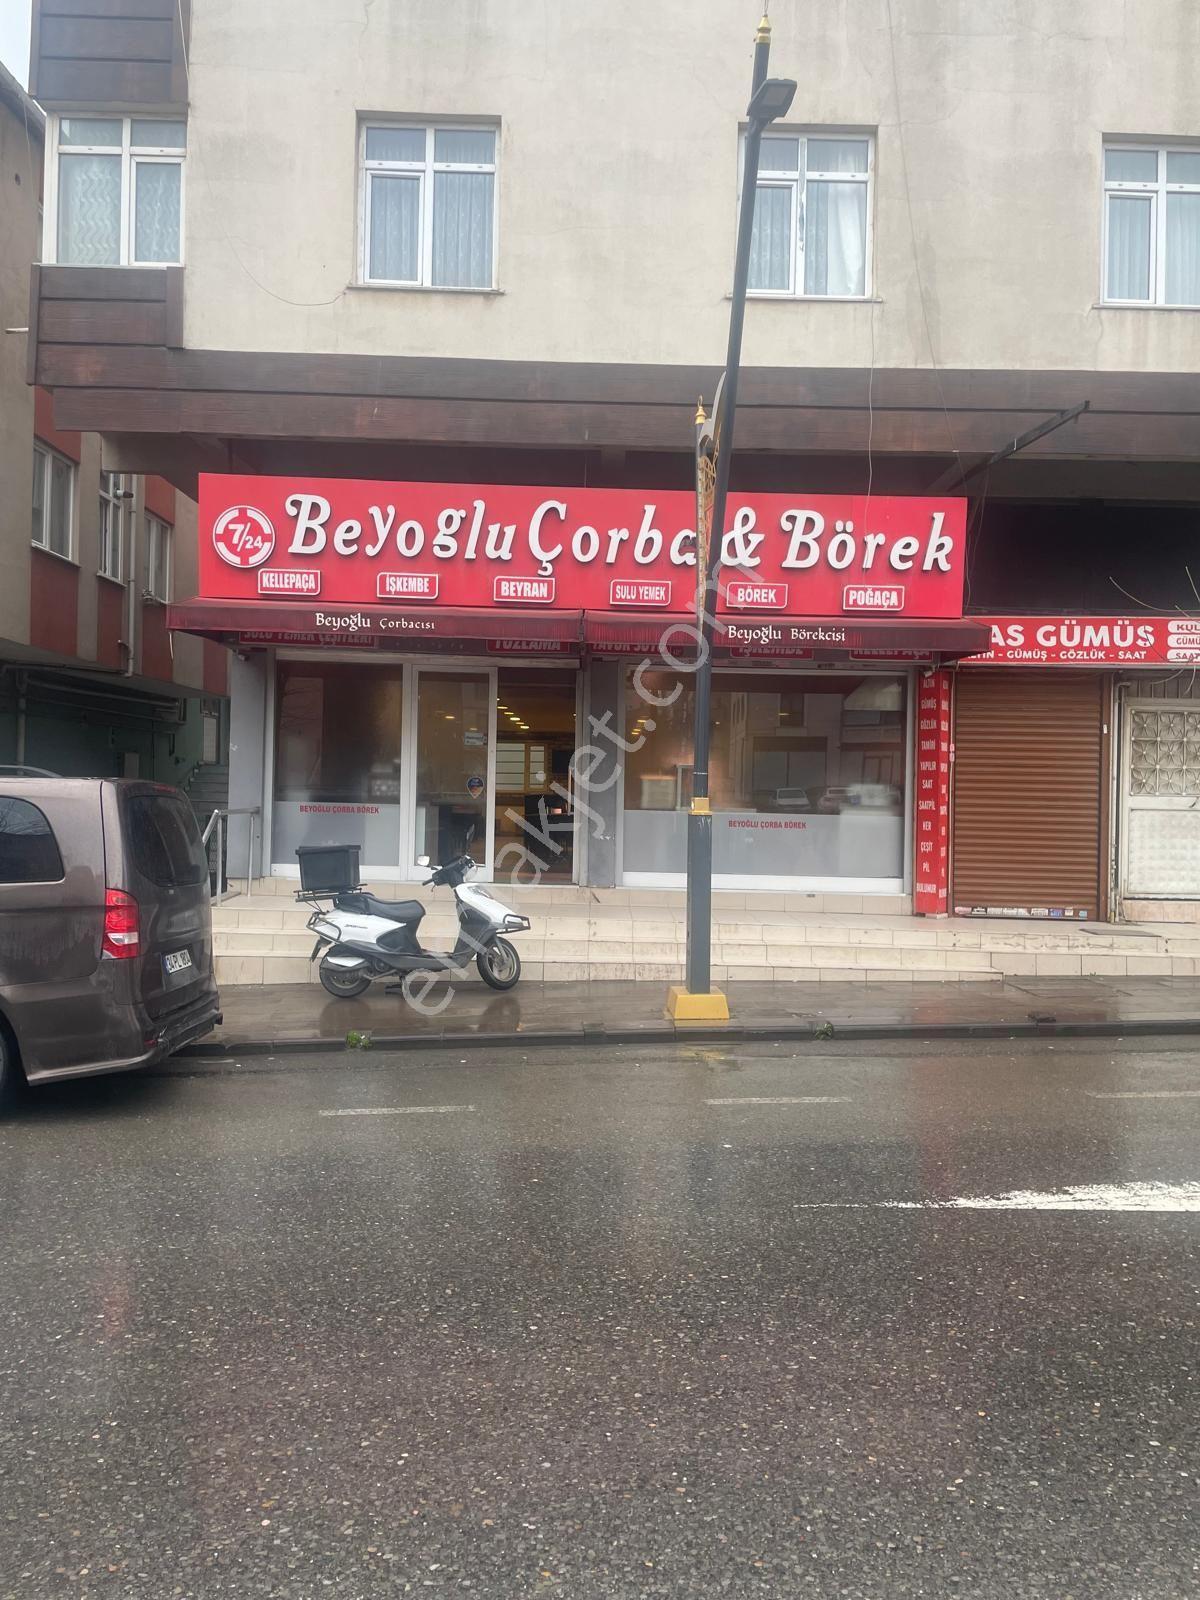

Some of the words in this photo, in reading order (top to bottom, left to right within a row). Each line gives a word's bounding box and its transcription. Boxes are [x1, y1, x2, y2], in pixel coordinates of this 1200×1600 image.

[228, 522, 263, 552] 7/24
[528, 499, 697, 576] Çorba
[720, 506, 765, 567] &
[780, 508, 954, 572] Börek
[262, 572, 316, 592] KELLEPAÇA
[385, 574, 430, 595] İŞKEMBE
[501, 581, 548, 598] BEYRAN
[616, 585, 637, 600] SULU
[639, 586, 666, 601] YEMEK
[737, 585, 776, 603] BÖREK
[849, 588, 899, 609] POĞAÇA
[315, 612, 371, 632] Beyoğlu
[379, 617, 435, 630] Çorbacısı
[727, 625, 782, 644] Beyoğlu
[1007, 649, 1047, 661] GÜMÜŞ
[1060, 649, 1105, 660] GÖZLÜK
[1118, 651, 1146, 660] SAAT
[922, 779, 933, 789] SAAT
